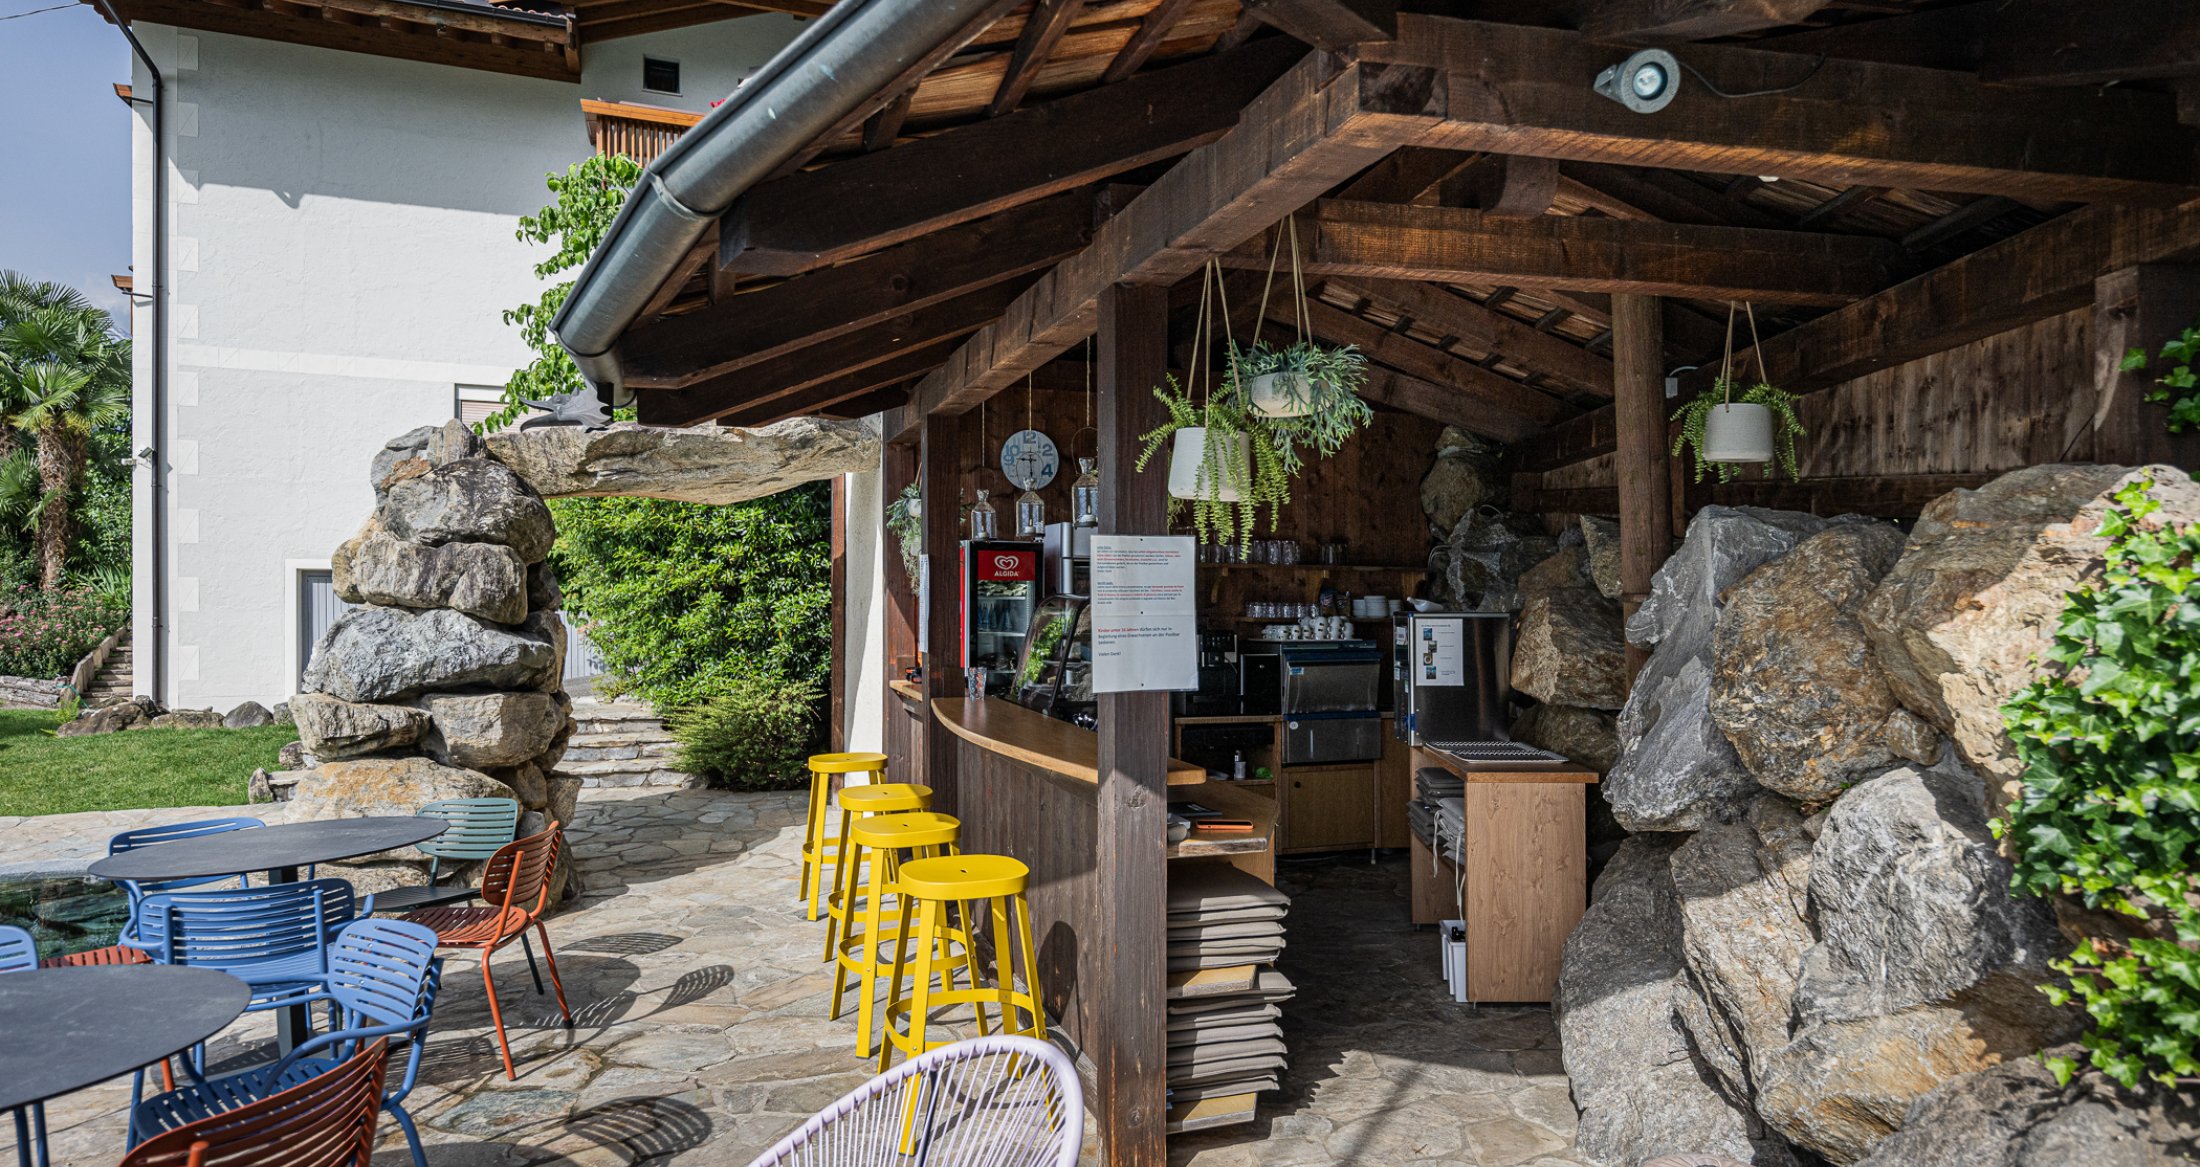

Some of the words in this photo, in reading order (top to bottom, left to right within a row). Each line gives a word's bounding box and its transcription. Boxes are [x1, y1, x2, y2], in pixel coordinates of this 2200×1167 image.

[1023, 431, 1037, 444] 12
[1042, 443, 1053, 456] 2
[1041, 464, 1054, 478] 4
